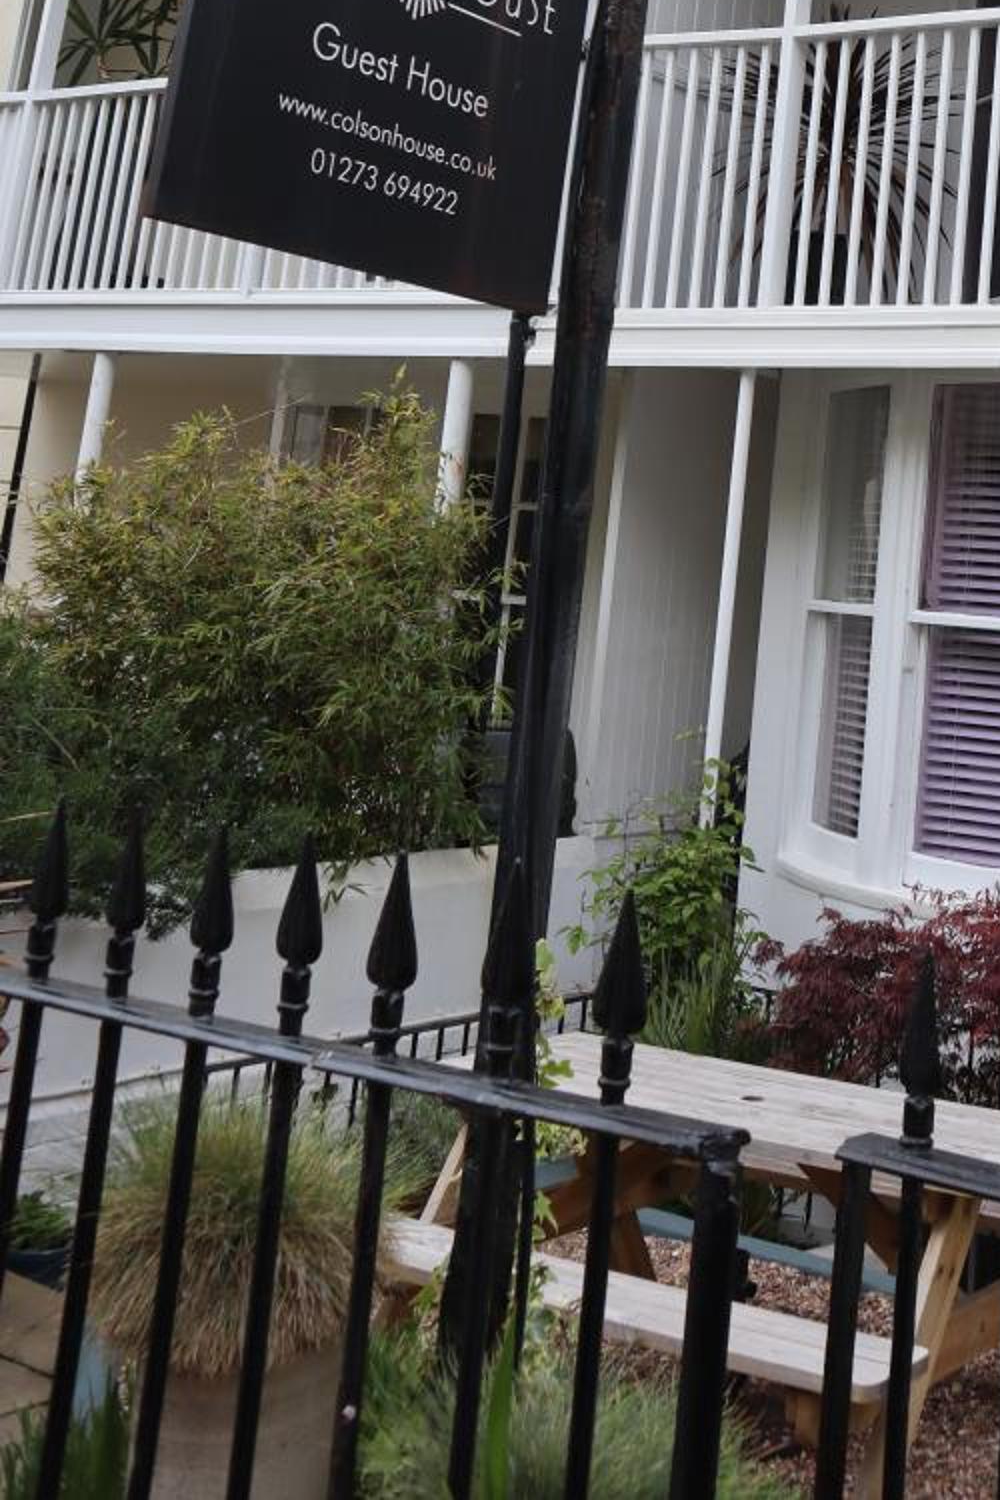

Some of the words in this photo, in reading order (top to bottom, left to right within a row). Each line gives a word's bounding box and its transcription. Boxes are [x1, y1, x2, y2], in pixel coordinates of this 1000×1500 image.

[312, 21, 400, 84] Guest
[407, 55, 489, 118] House
[278, 91, 497, 182] www.colsonhouse.co.uk
[311, 147, 379, 191] 01273
[382, 170, 460, 216] 694922
